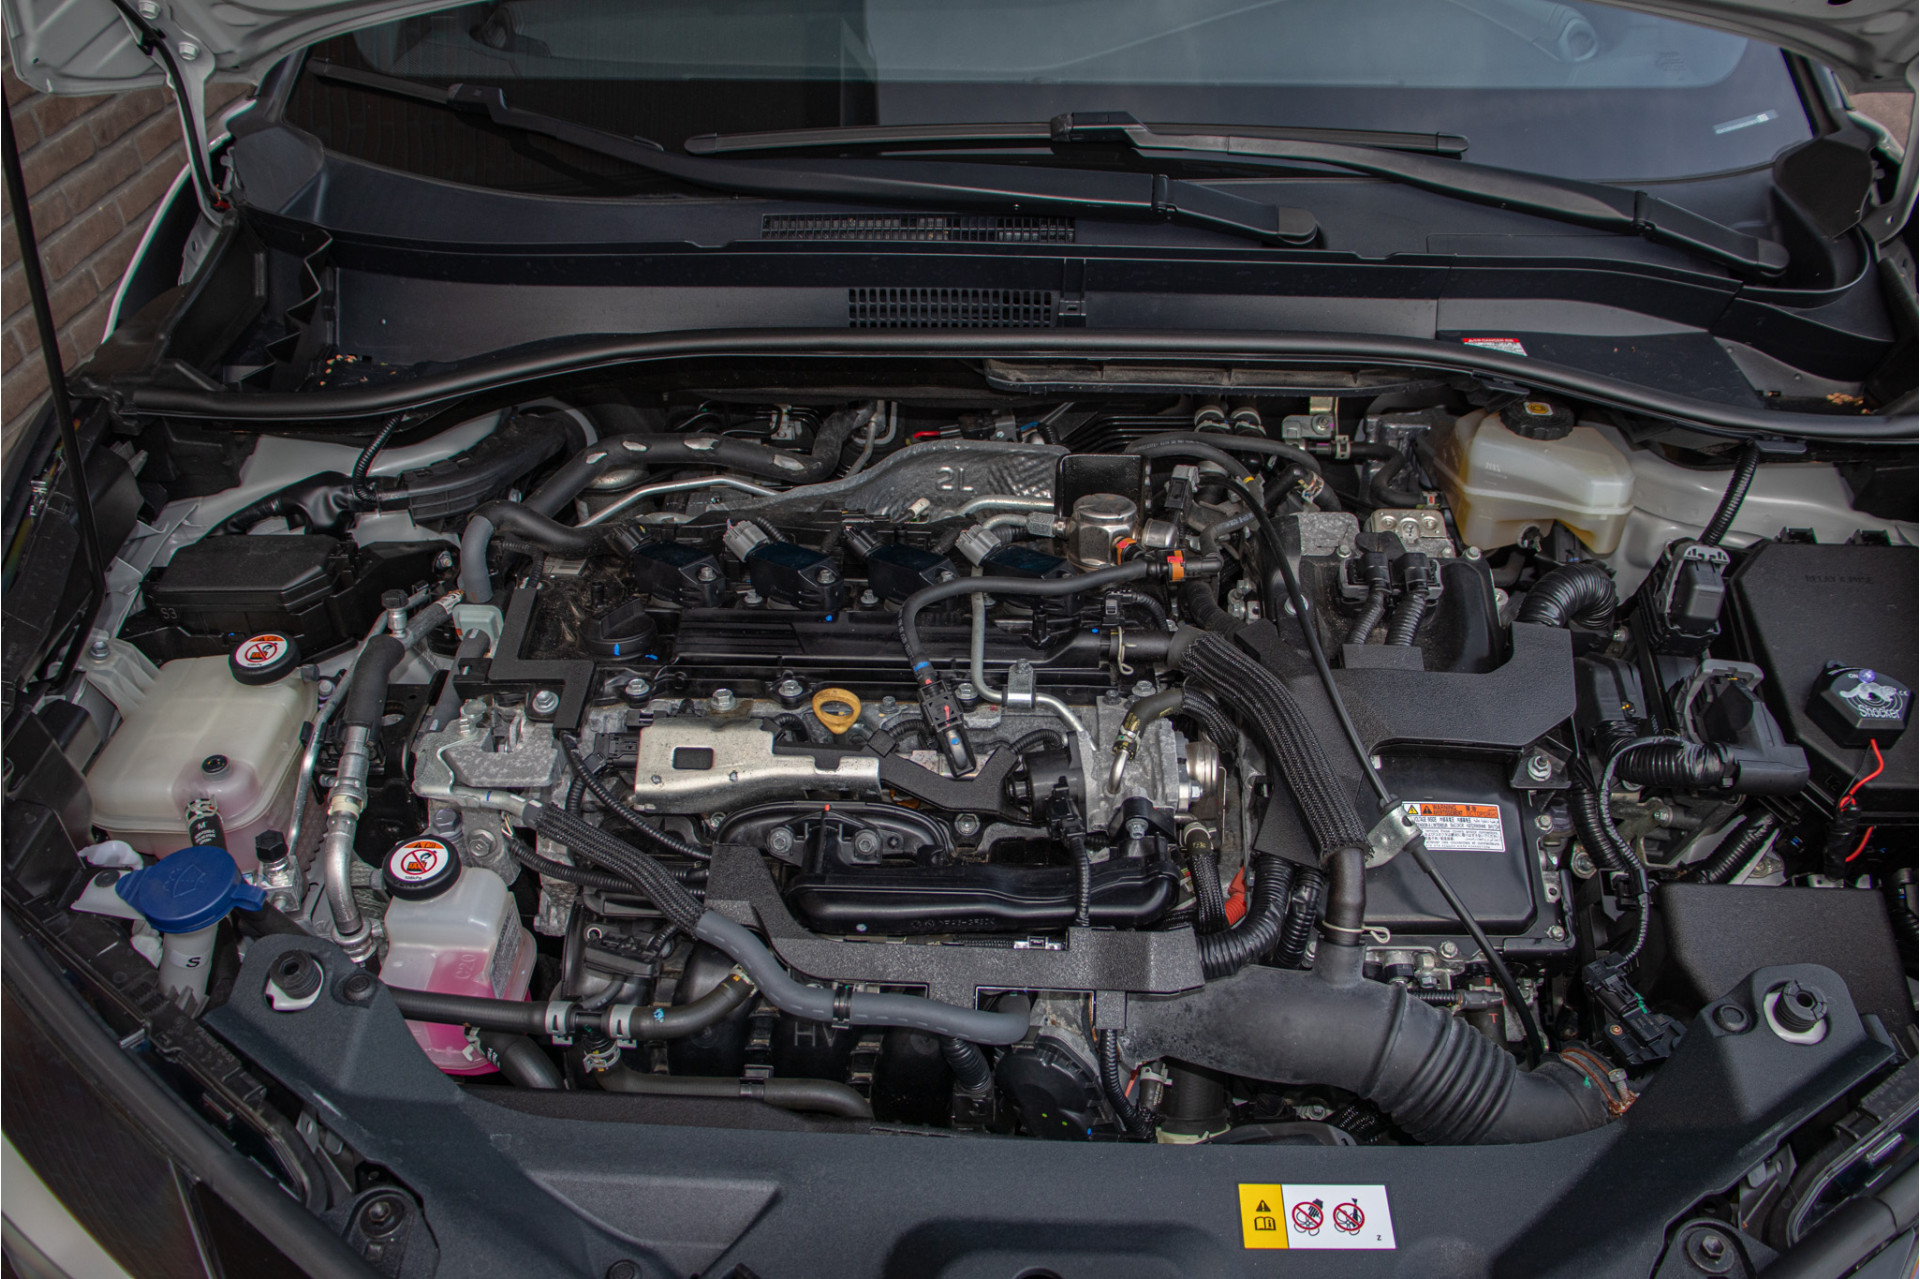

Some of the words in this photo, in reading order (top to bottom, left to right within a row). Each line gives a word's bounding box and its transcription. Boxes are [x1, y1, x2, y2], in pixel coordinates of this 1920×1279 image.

[937, 465, 974, 491] 2L
[160, 607, 178, 620] S3
[1858, 704, 1901, 719] Shocker
[185, 956, 202, 968] S
[793, 1021, 838, 1048] HV
